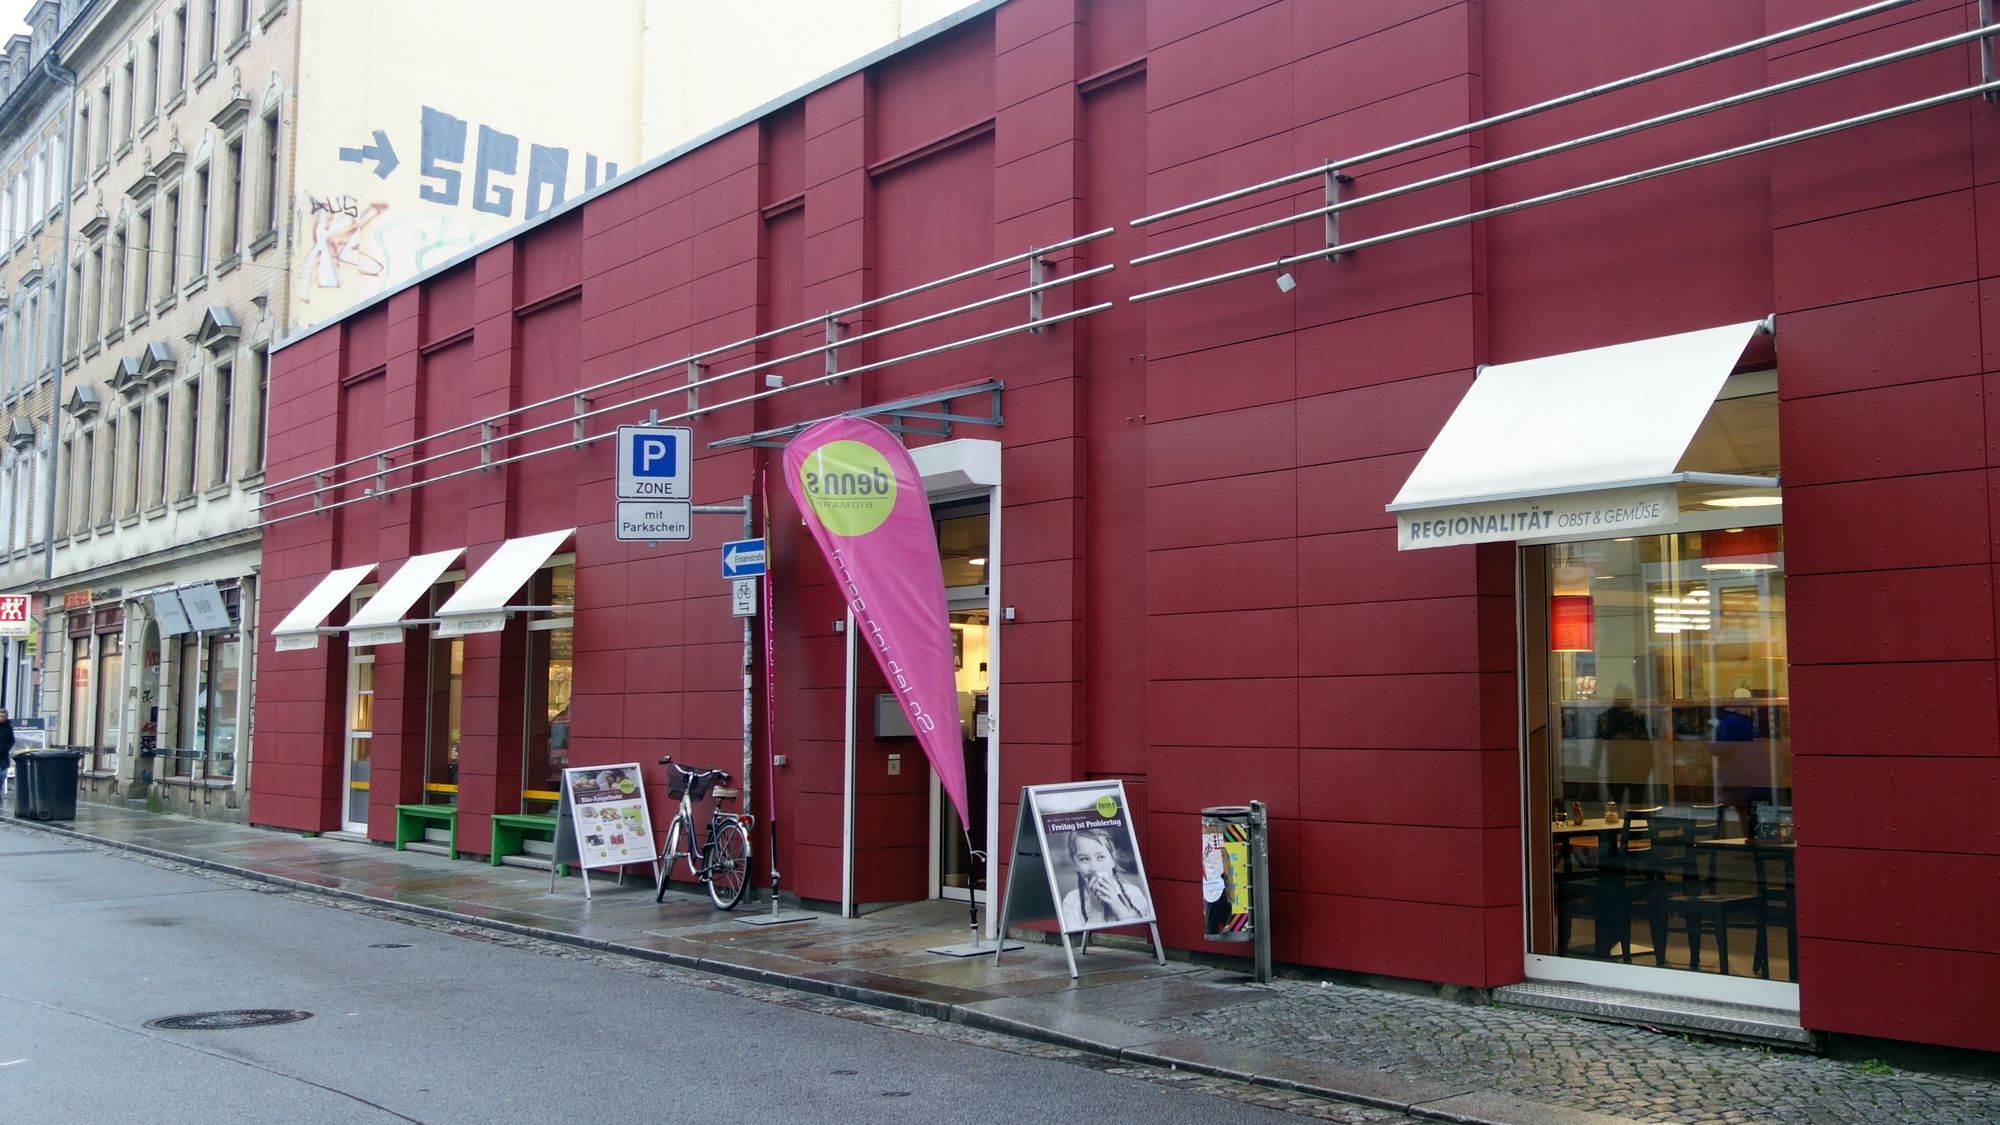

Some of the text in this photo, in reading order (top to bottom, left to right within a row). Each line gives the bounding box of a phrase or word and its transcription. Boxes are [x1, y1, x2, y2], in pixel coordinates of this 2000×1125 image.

[643, 440, 666, 472] P
[635, 482, 673, 494] ZONE
[645, 509, 663, 520] mit
[623, 521, 685, 532] Parkschein
[1411, 502, 1660, 540] REGIONALITÄT OBST & GEMÜSE
[581, 794, 623, 803] Bio-Angebote
[1051, 823, 1076, 832] Freitag
[1085, 819, 1122, 828] Probiertag
